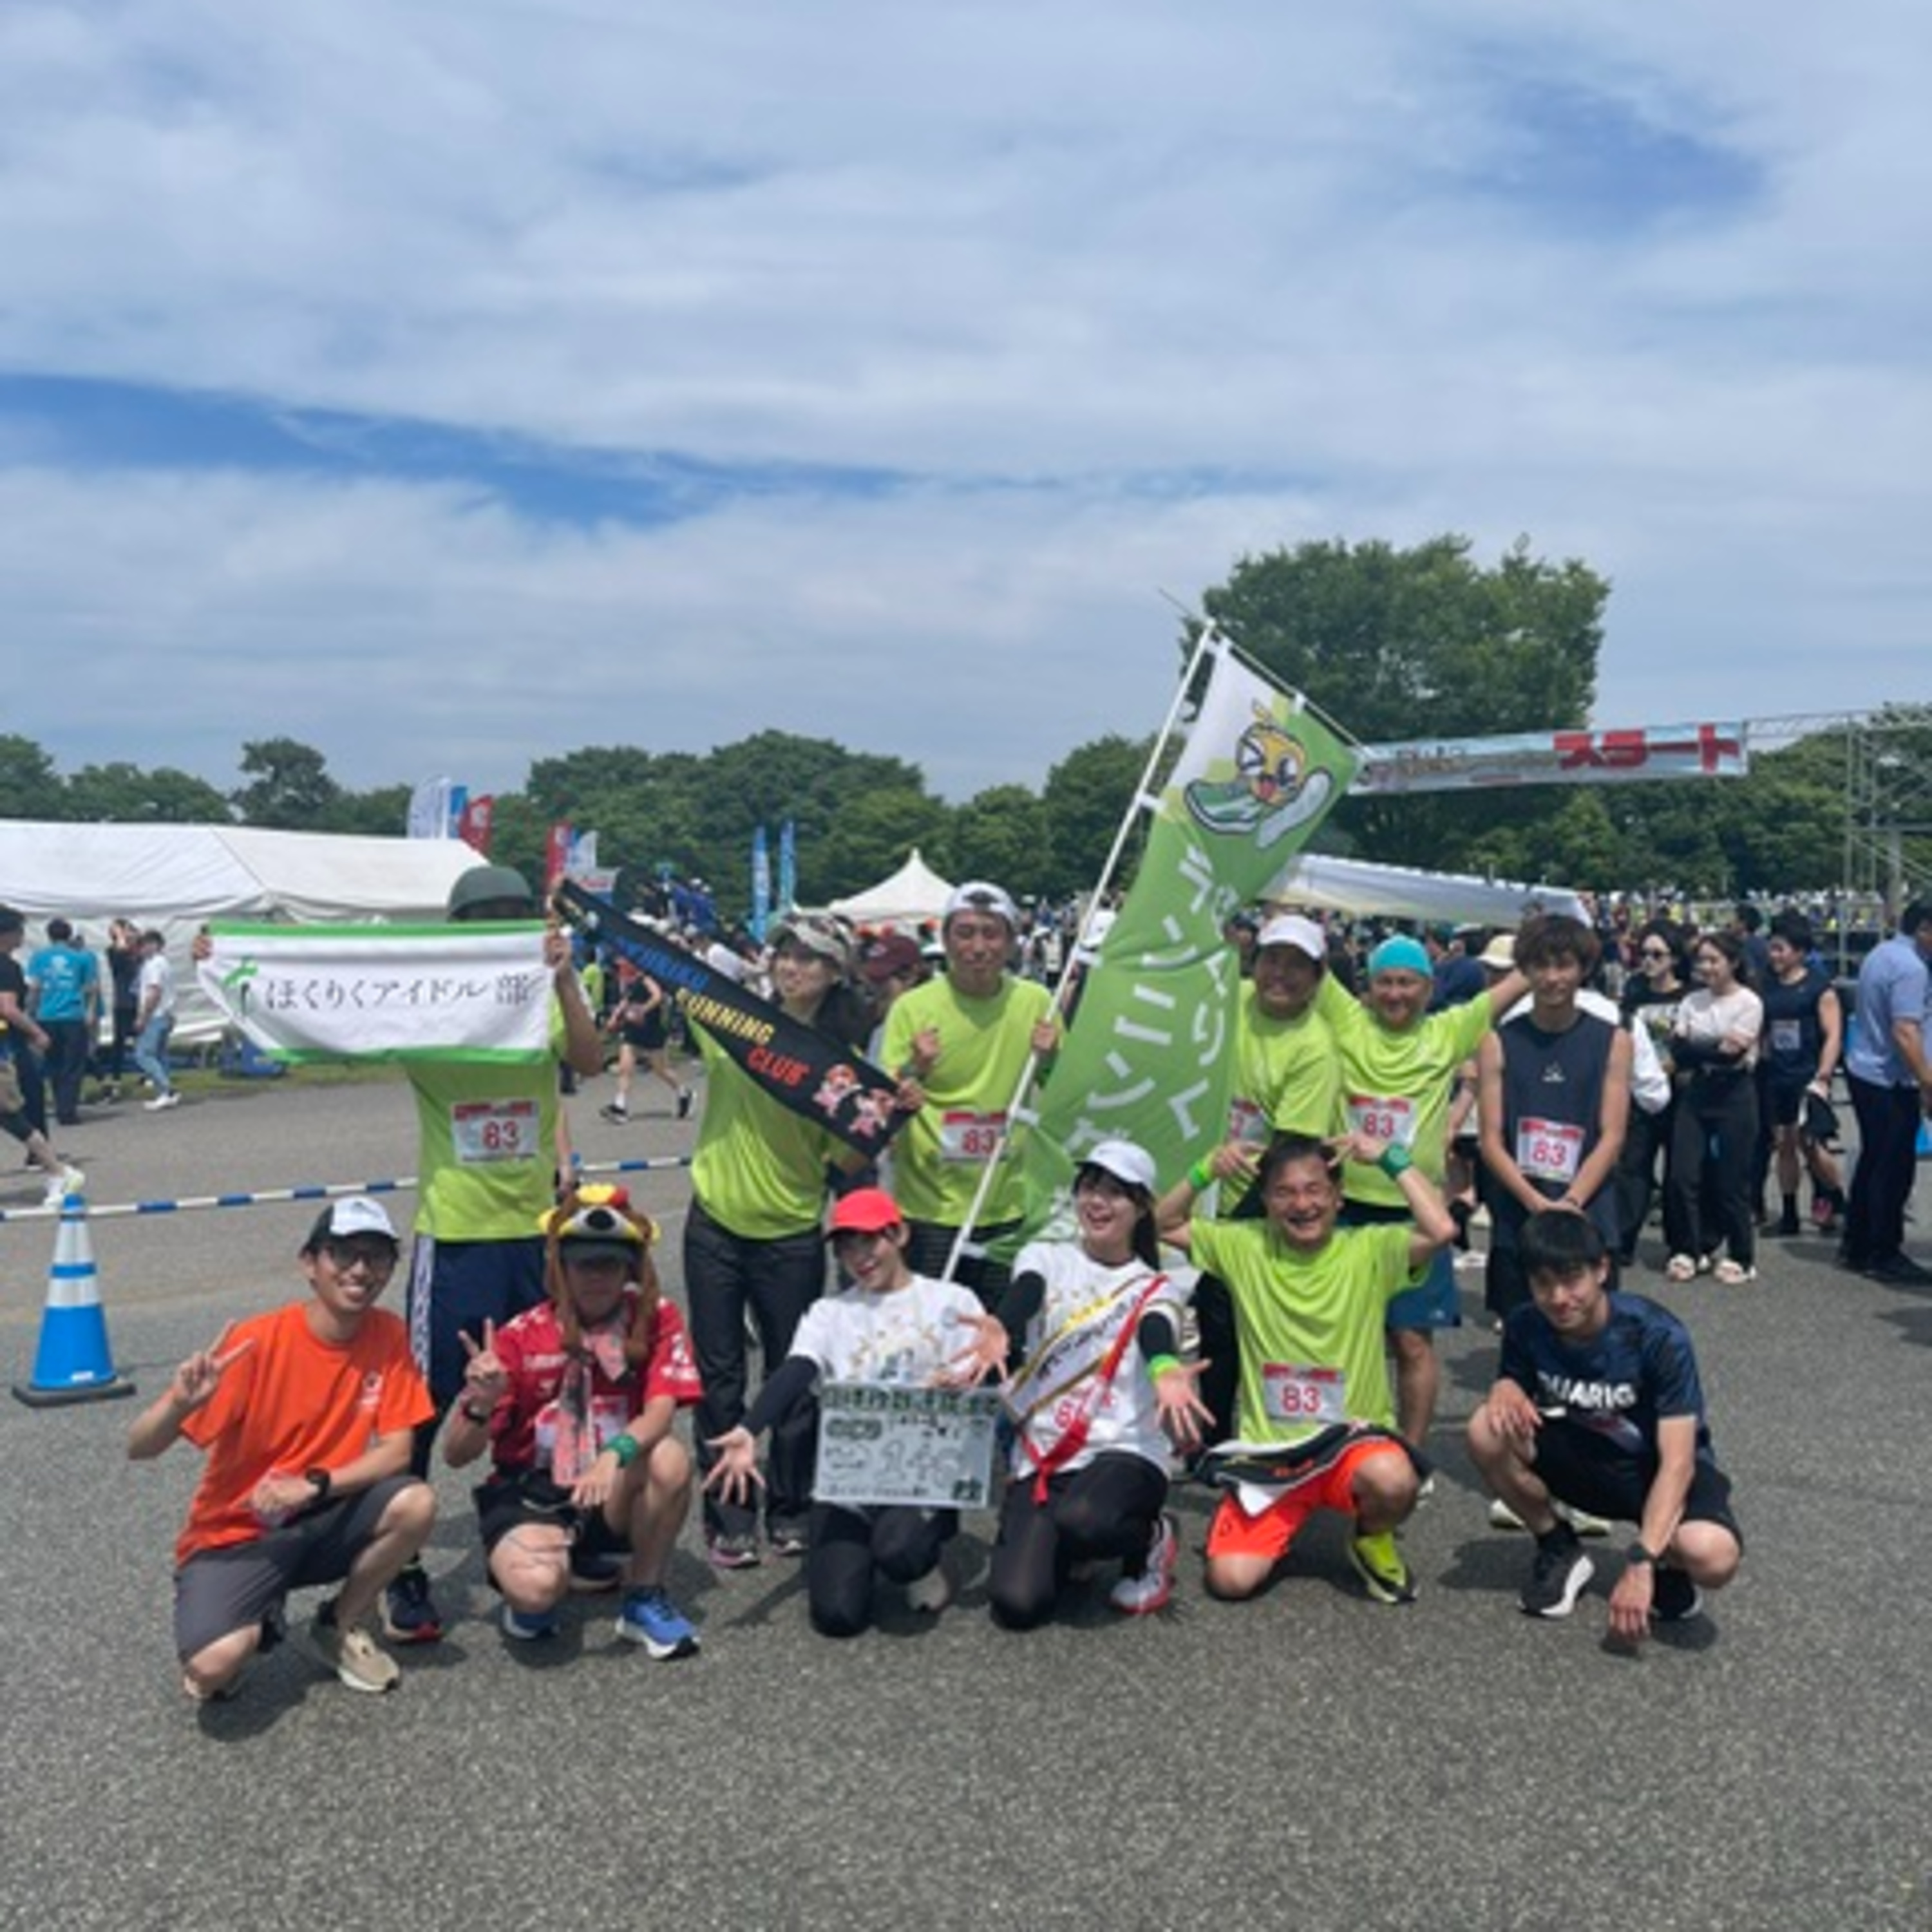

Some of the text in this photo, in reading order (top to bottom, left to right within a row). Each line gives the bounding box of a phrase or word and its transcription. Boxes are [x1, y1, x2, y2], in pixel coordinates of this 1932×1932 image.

[1553, 723, 1739, 775] スタート
[265, 971, 546, 1009] ほくりくアイドル部
[748, 1046, 810, 1086] CLUB
[483, 1120, 520, 1151] 83
[1363, 1112, 1394, 1139] 83
[962, 1128, 996, 1155] 83
[1532, 1139, 1566, 1168] 83
[1282, 1386, 1320, 1413] 83
